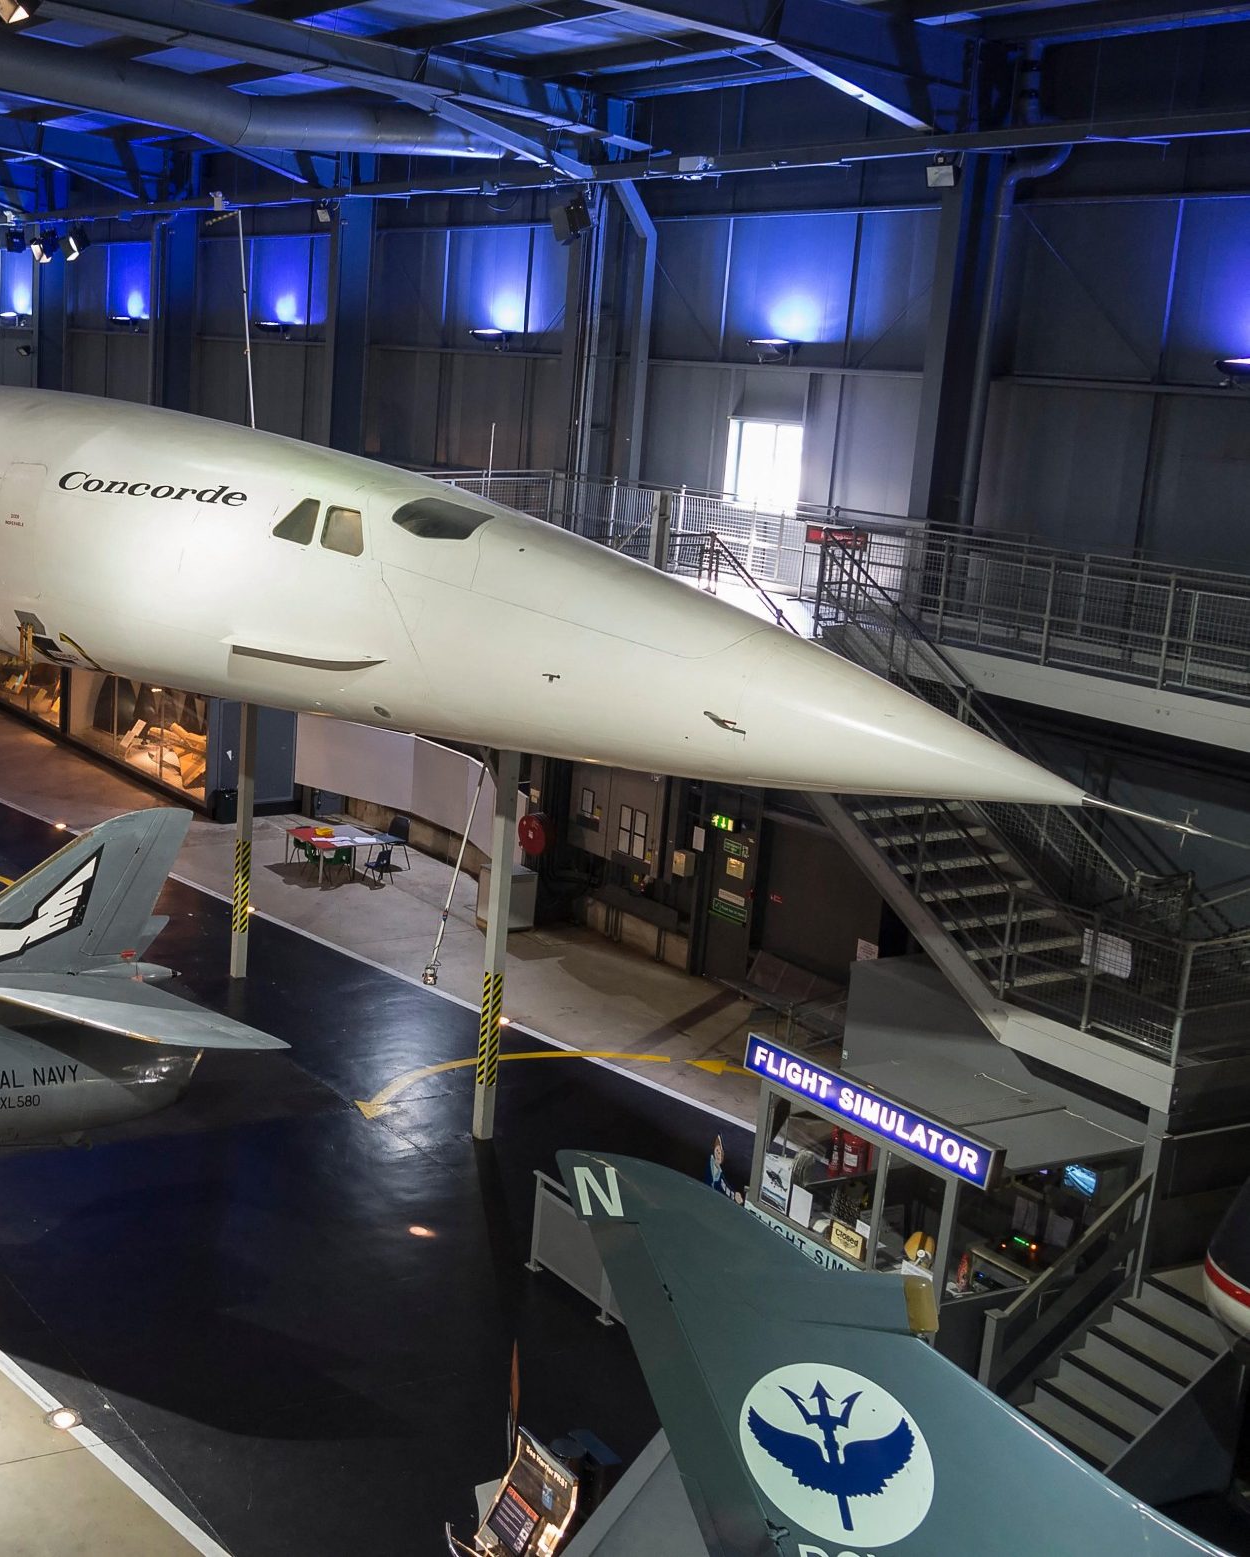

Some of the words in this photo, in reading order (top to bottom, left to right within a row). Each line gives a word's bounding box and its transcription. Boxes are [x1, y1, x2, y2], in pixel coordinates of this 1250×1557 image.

[58, 470, 248, 507] Concorde
[32, 1064, 79, 1087] NAVY
[0, 1094, 41, 1110] XL580
[753, 1045, 833, 1099] FLIGHT
[838, 1087, 980, 1175] SIMULATOR
[573, 1166, 624, 1217] N
[835, 1228, 859, 1247] Closed
